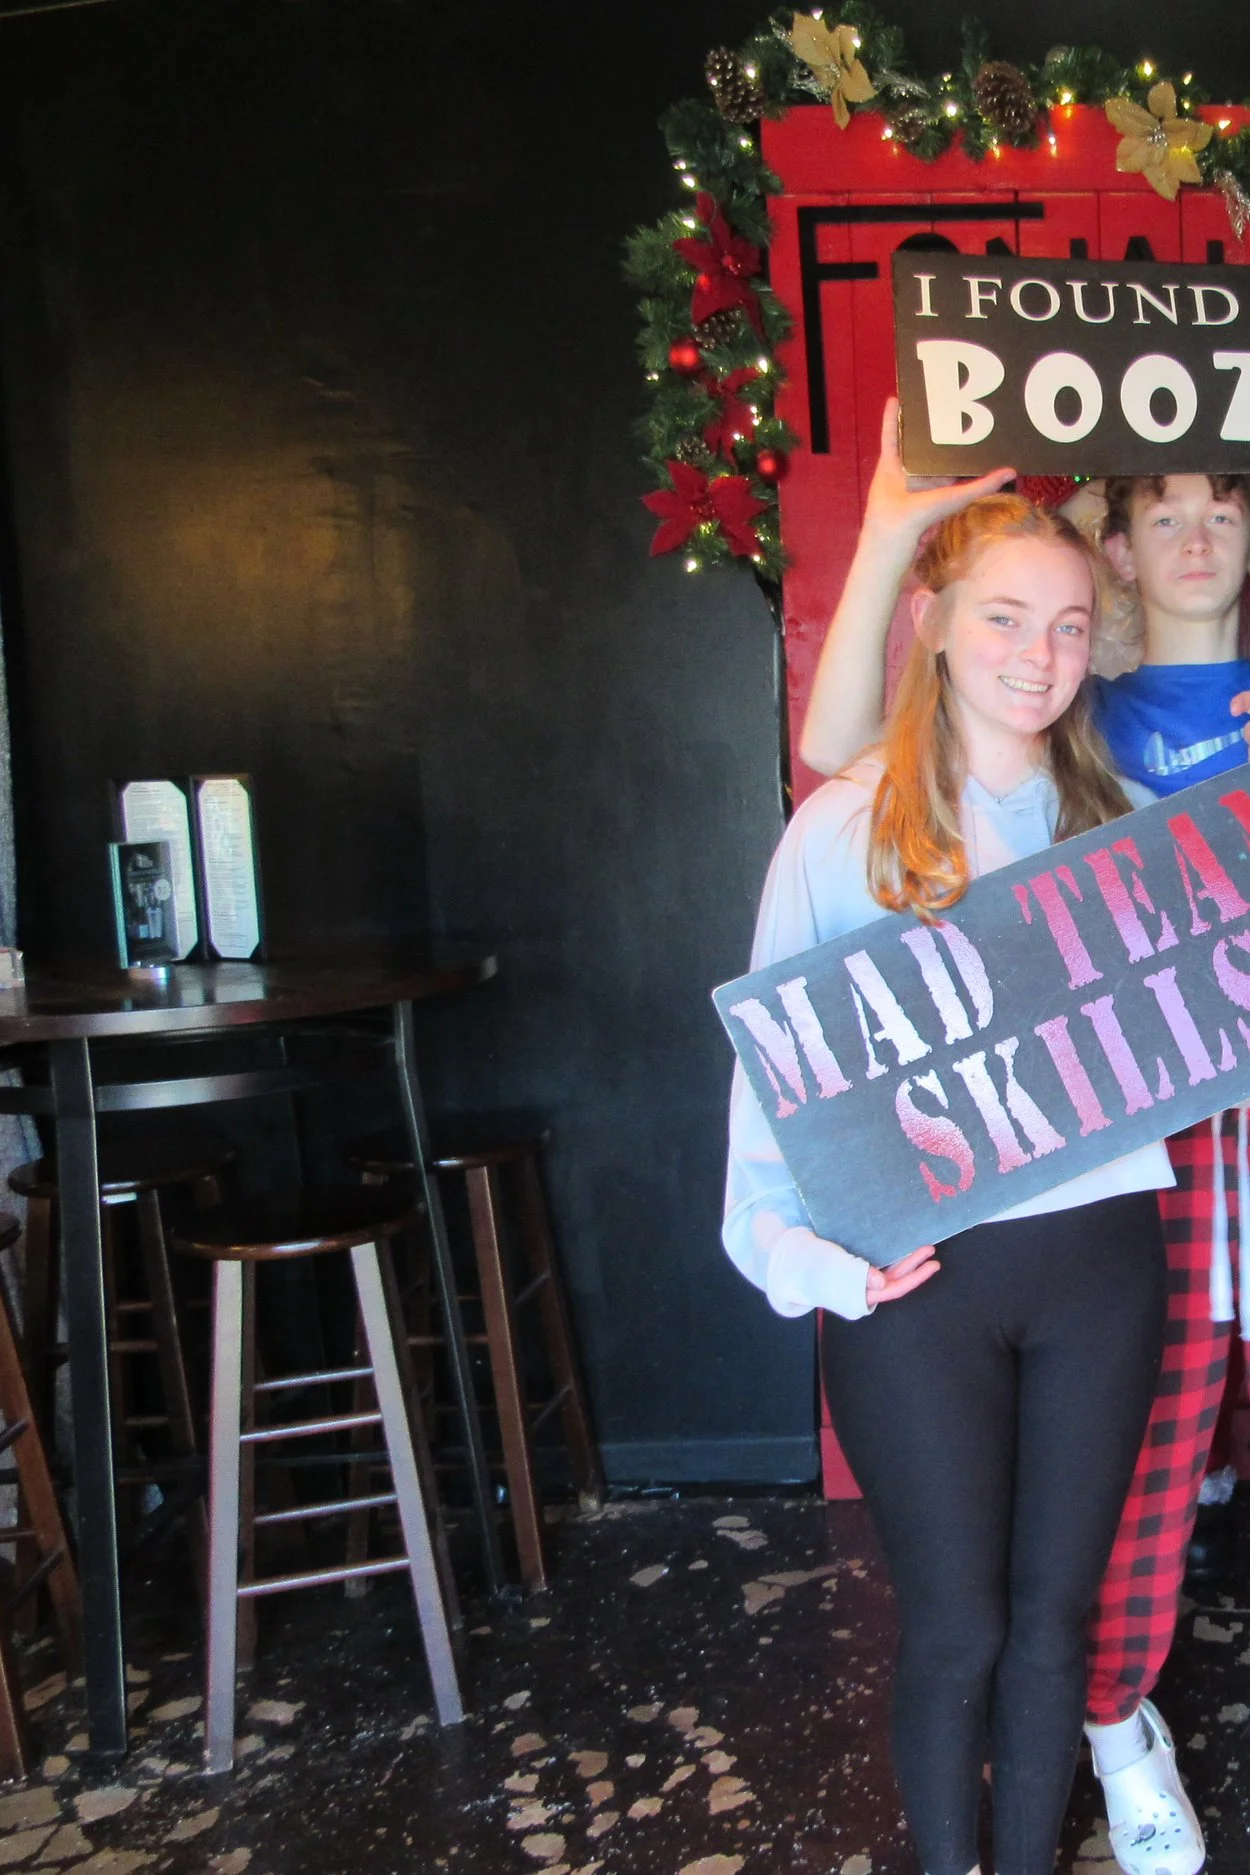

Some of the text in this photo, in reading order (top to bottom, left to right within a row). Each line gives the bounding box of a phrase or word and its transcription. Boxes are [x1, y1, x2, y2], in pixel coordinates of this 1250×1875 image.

[915, 275, 937, 318] I
[963, 277, 1239, 326] FOUND
[729, 920, 994, 1120] MAD
